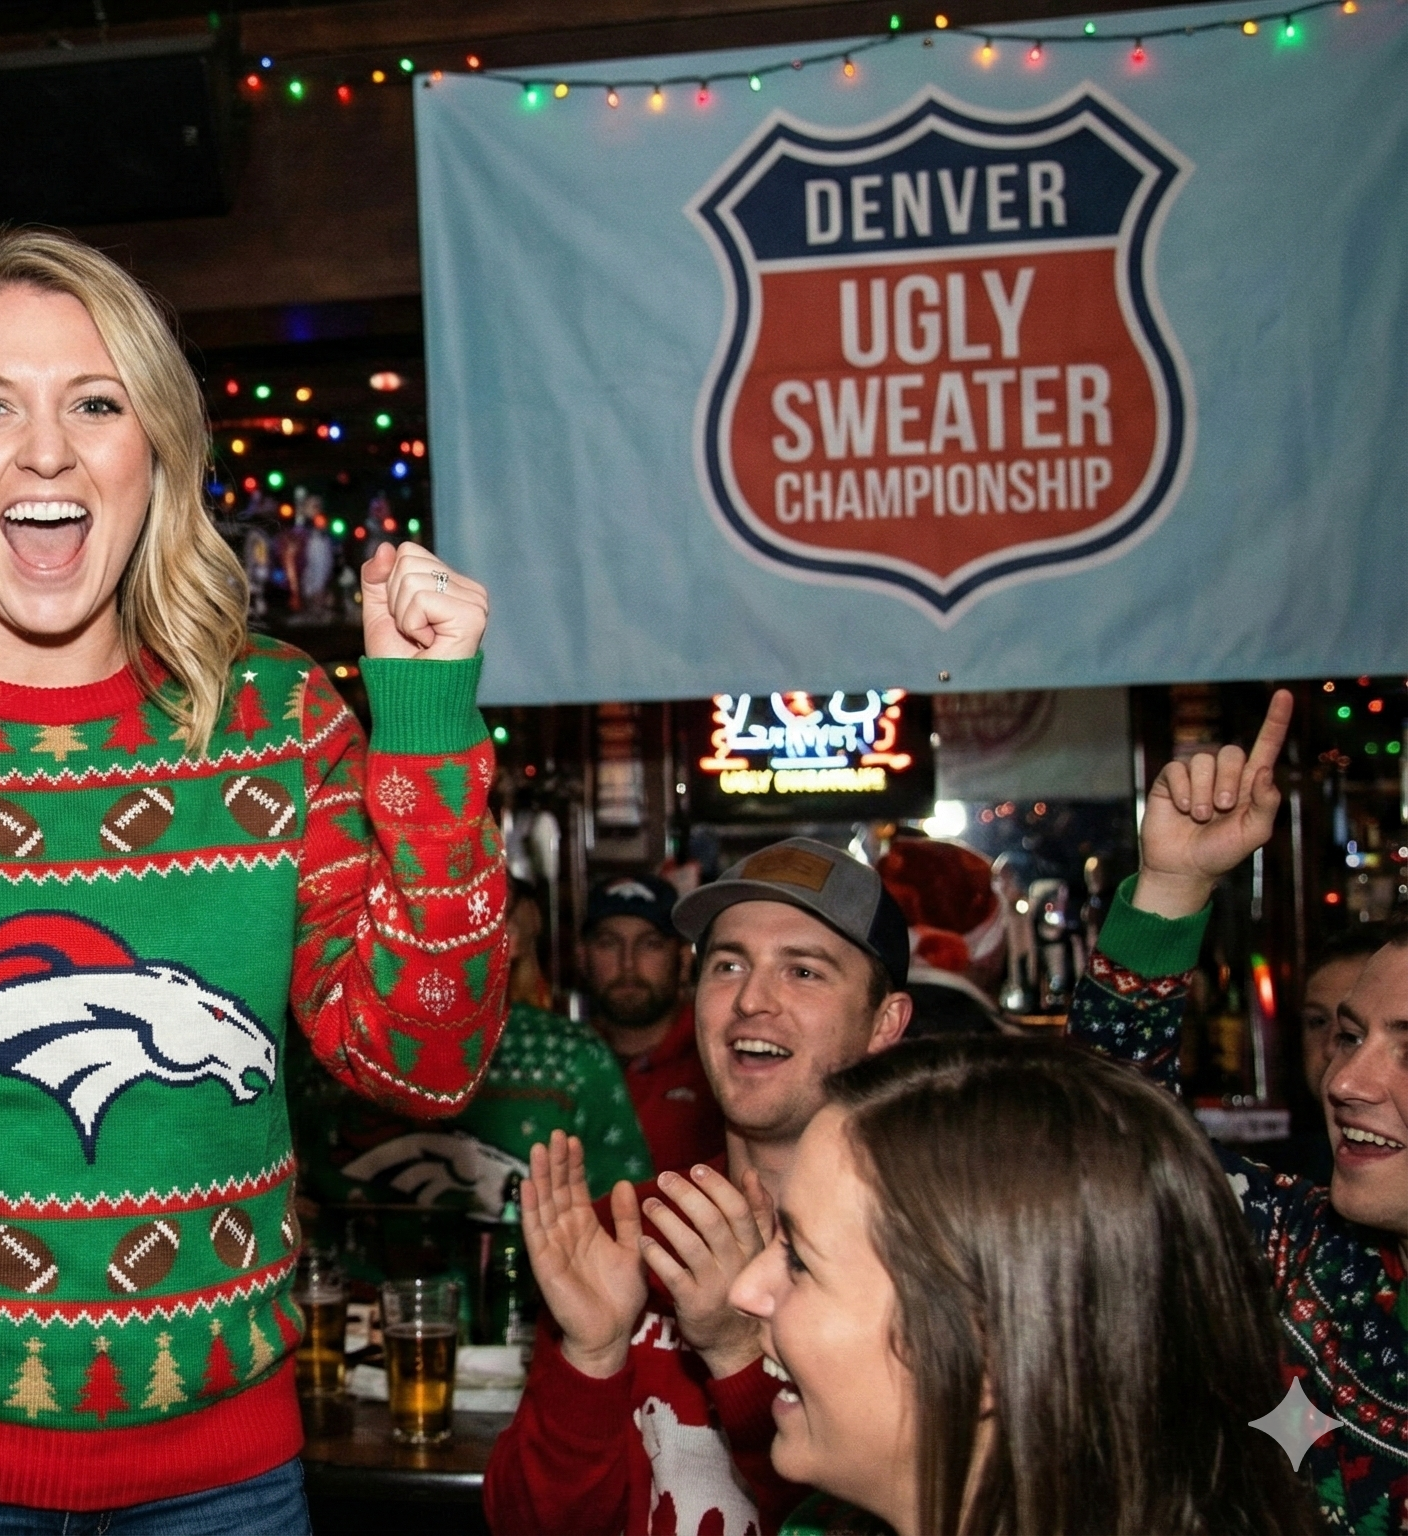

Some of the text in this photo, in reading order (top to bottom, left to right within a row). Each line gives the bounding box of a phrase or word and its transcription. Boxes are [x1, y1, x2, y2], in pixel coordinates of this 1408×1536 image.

[804, 159, 1068, 247] DENVER
[838, 266, 1037, 369] UGLY
[770, 363, 1114, 463] SWEATER
[774, 456, 1113, 524] CHAMPIONSHIP
